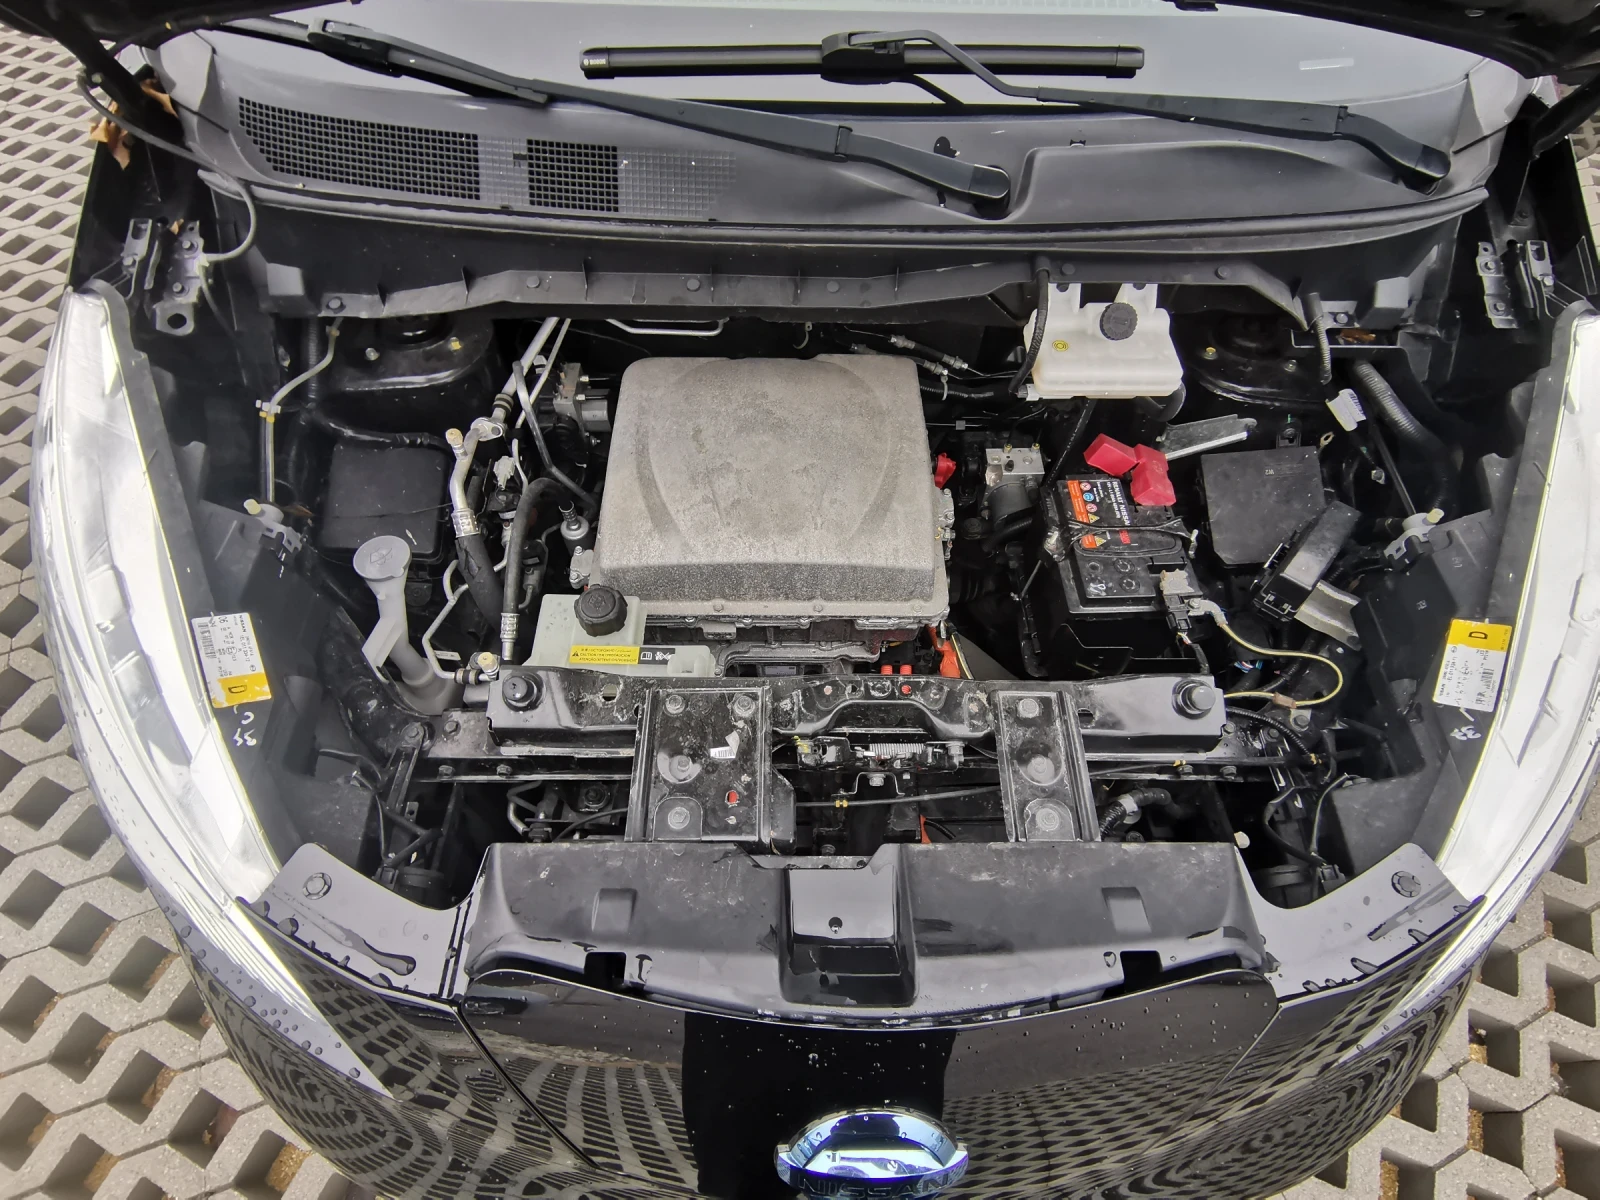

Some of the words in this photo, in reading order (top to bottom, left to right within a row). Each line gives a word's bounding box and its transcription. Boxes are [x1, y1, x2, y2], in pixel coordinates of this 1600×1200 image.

[1112, 481, 1124, 503] RENAULT
[1468, 631, 1488, 640] D
[228, 684, 248, 694] D
[798, 1173, 950, 1199] NISSAN
